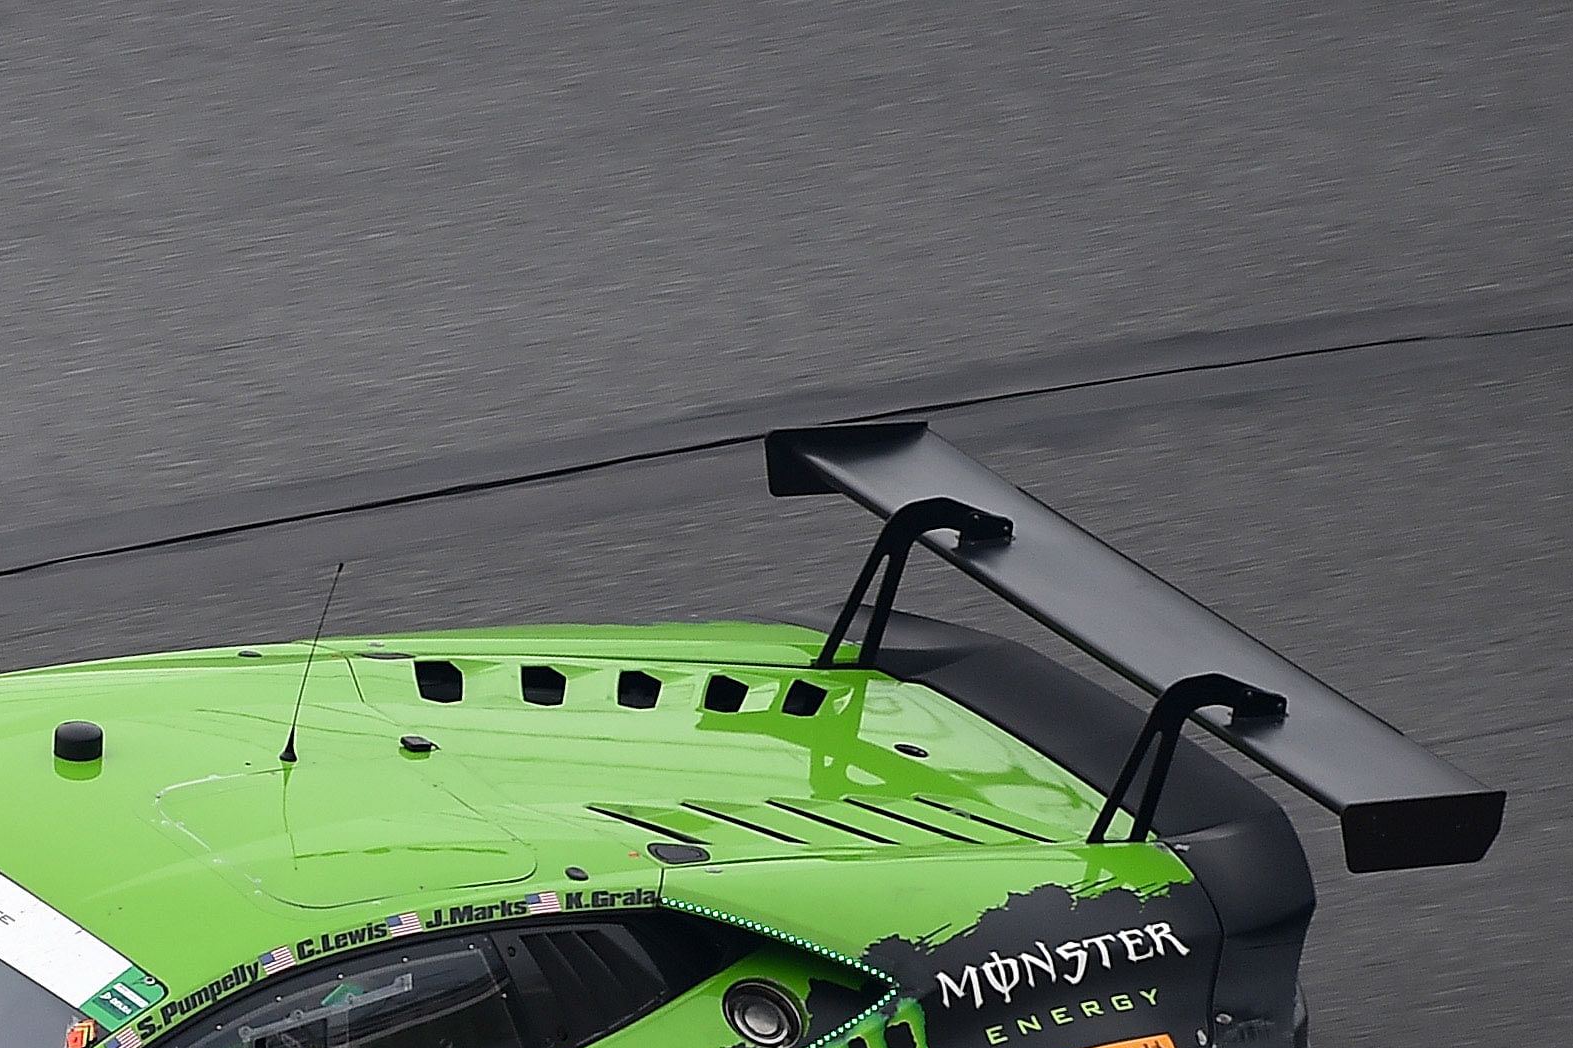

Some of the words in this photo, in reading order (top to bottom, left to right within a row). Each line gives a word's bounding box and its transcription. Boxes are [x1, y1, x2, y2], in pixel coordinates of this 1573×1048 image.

[425, 901, 527, 929] J.Marks
[296, 921, 388, 961] C.Lewis
[136, 957, 260, 1040] S.Pumpelly
[985, 988, 1159, 1045] ENERGY
